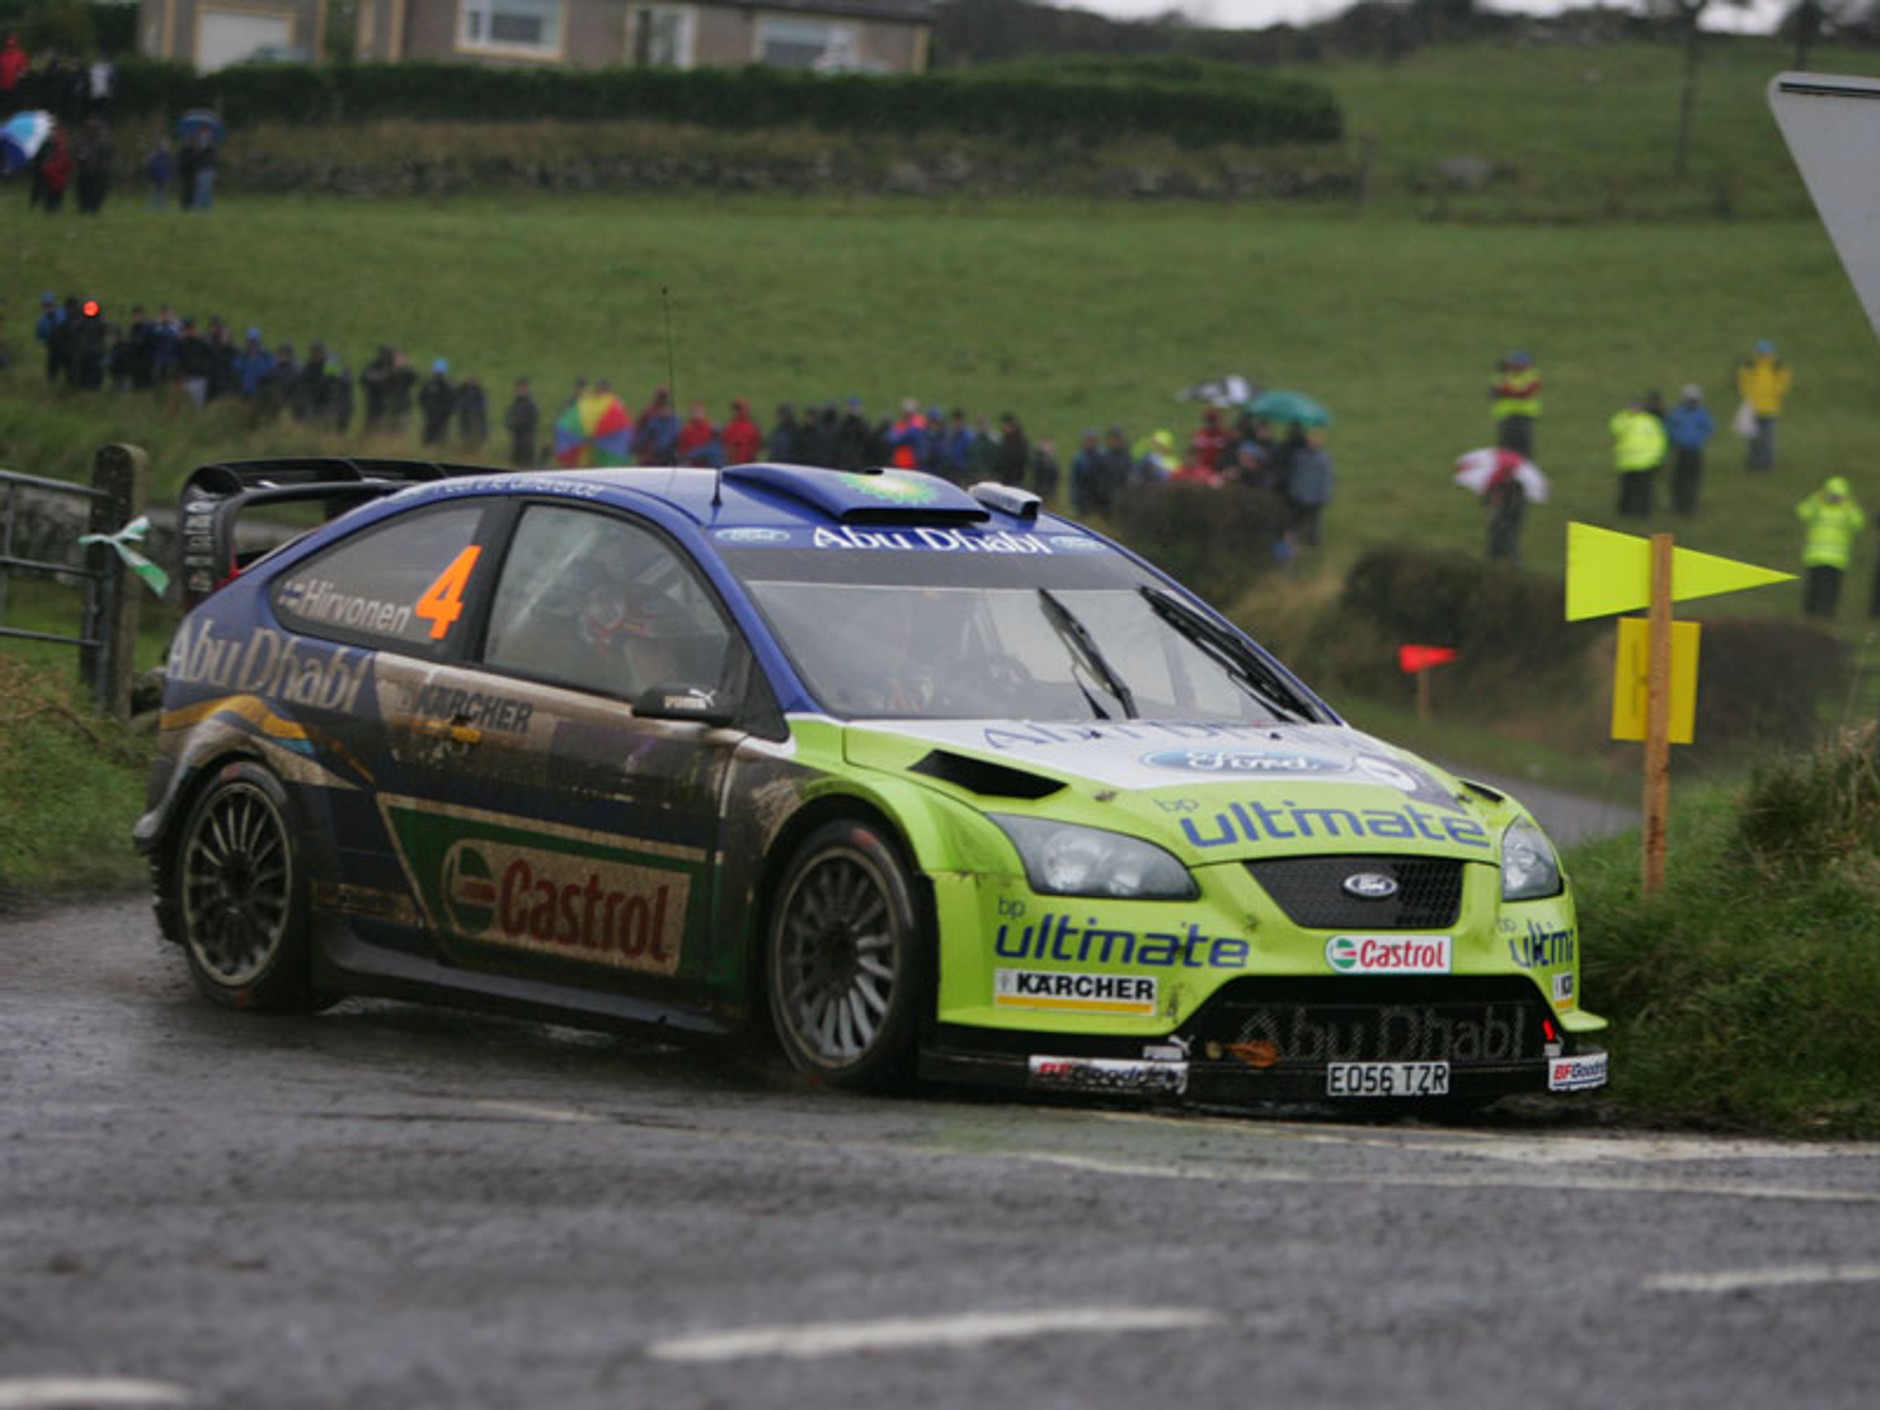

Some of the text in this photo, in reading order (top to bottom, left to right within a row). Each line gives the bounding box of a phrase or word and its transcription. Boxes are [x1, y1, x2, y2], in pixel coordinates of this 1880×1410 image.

[813, 525, 912, 550] Abu
[913, 528, 1053, 555] Dhabi
[302, 578, 411, 632] Hirvonen
[415, 546, 482, 639] 4
[166, 619, 374, 713] Abu Dhabi
[1185, 752, 1318, 772] Ford
[1180, 798, 1491, 848] ultimate
[502, 858, 670, 963] Castrol
[998, 898, 1026, 920] bp
[995, 913, 1250, 968] ultimate
[1360, 938, 1445, 968] Castrol
[1403, 1064, 1448, 1092] TZR
